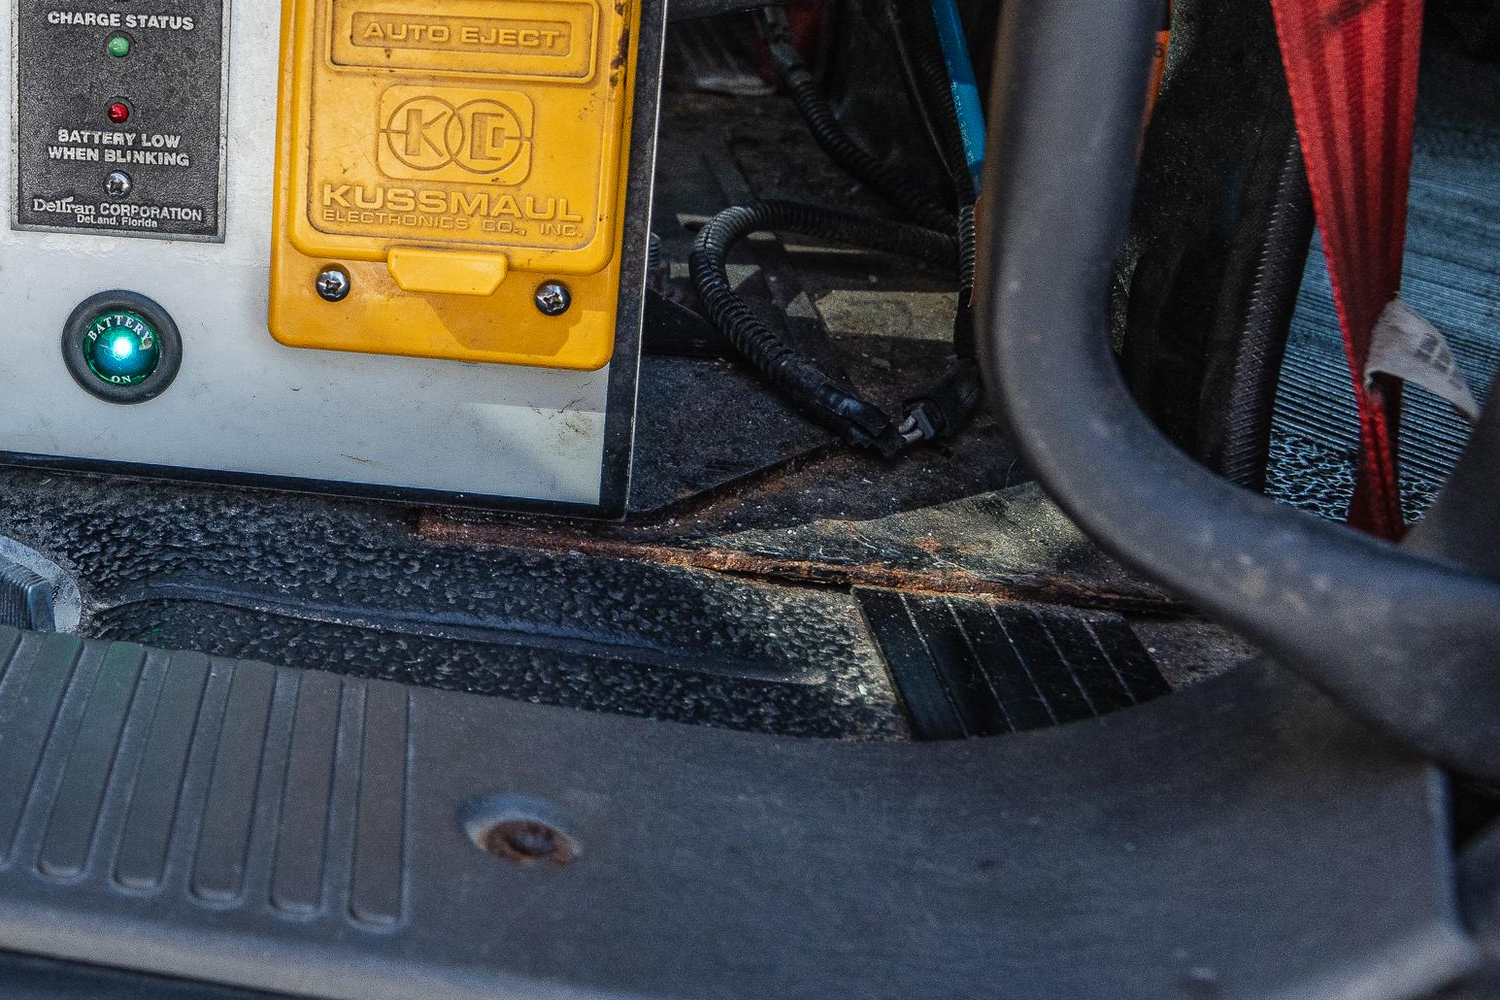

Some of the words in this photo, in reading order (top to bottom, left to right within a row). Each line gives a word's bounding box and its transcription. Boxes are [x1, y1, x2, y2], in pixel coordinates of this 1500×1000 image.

[47, 11, 121, 27] CHARGE
[125, 14, 195, 31] STATUS
[363, 21, 451, 43] AUTO
[460, 26, 562, 48] EJECT
[57, 127, 137, 147] BATTERY
[141, 133, 182, 149] LOW
[48, 146, 100, 162] WHEN
[104, 149, 190, 167] BLINKING
[99, 202, 203, 222] CORPORATION
[321, 182, 584, 223] KUSSMAUL
[121, 216, 158, 229] Florida
[322, 208, 470, 231] ELECTRONICS
[539, 223, 584, 238] INC.
[87, 314, 154, 342] BATTERY
[111, 374, 132, 385] ON
